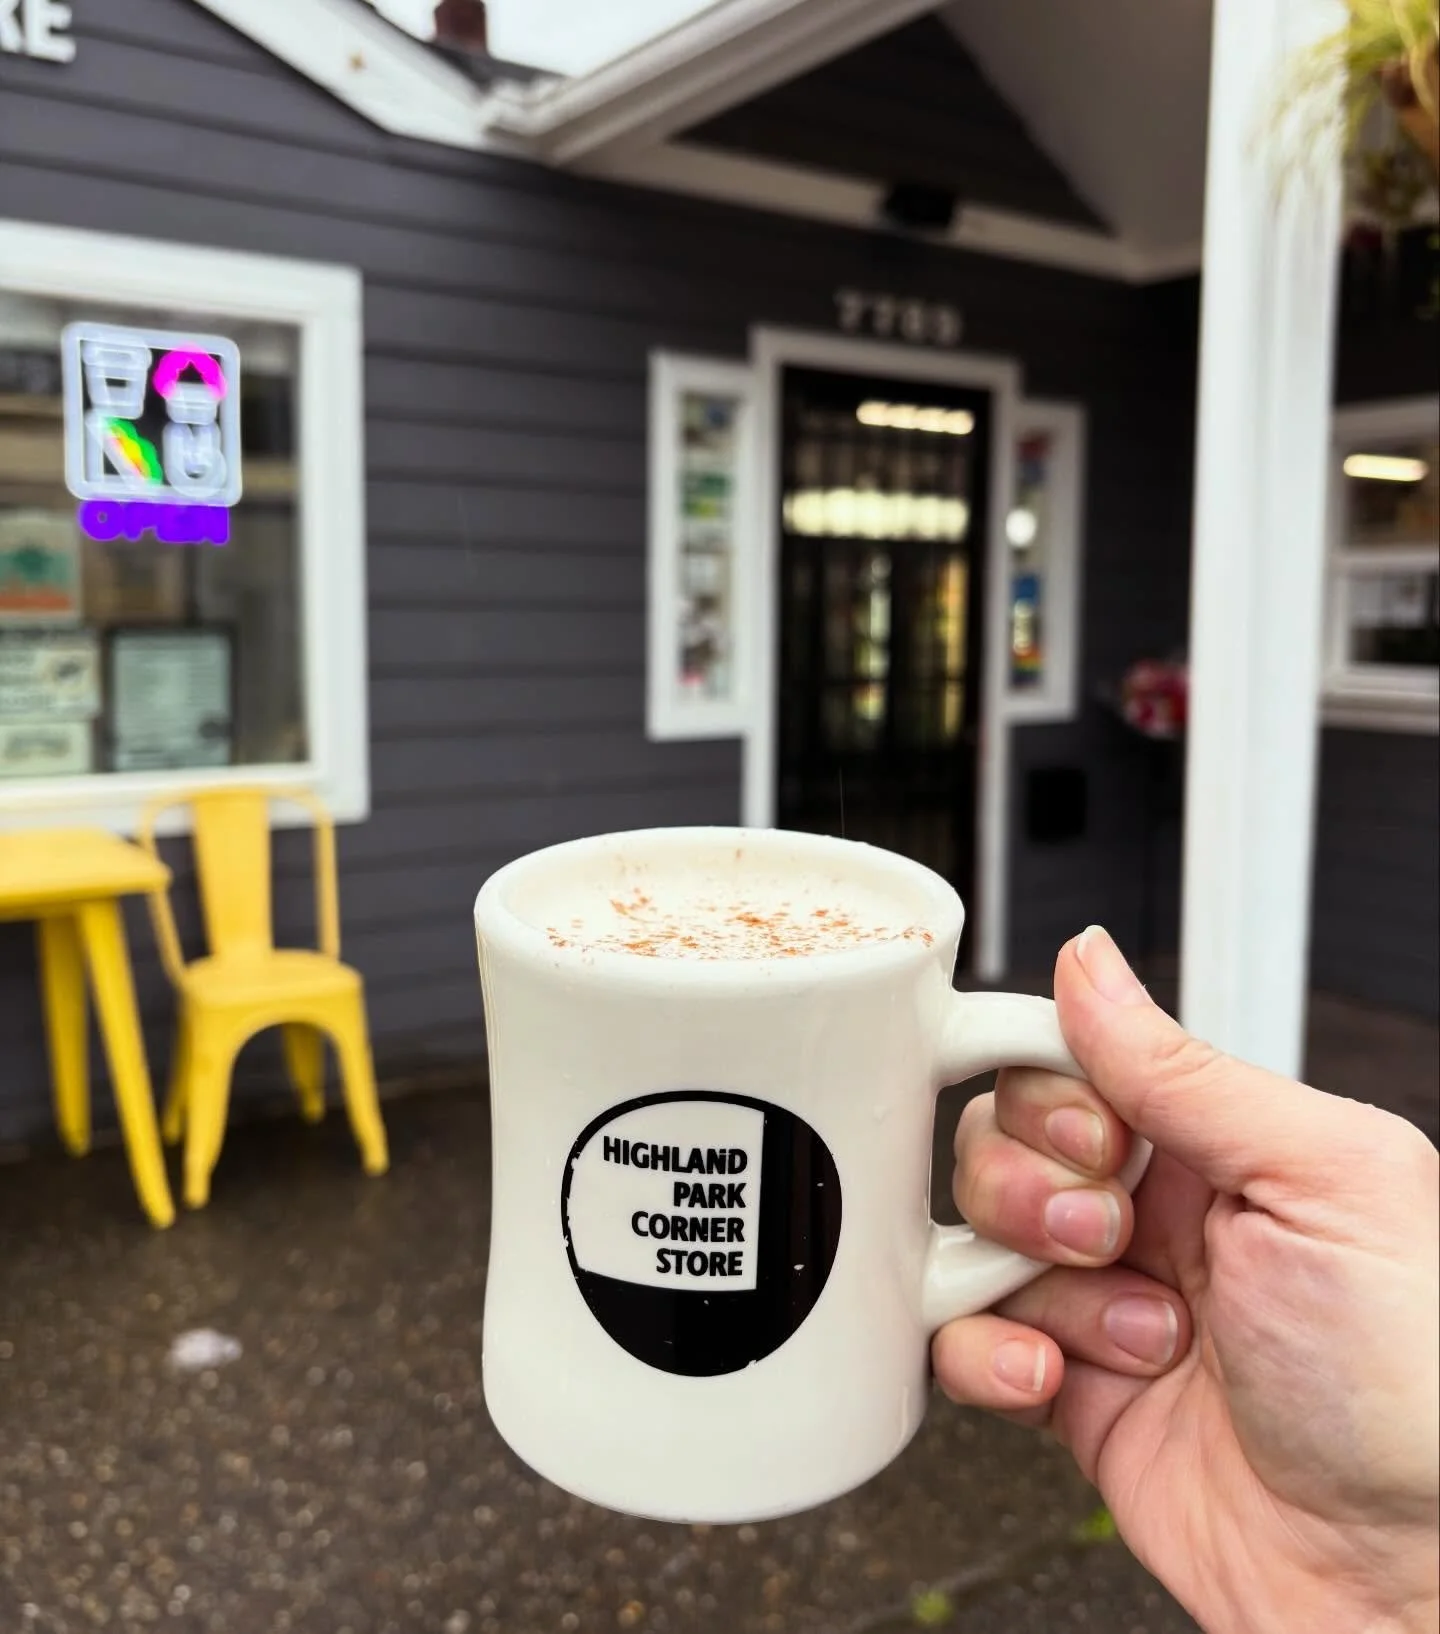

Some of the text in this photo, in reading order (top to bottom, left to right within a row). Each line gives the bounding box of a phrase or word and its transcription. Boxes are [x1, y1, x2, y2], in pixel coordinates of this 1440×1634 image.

[603, 1135, 748, 1175] HIGHLAND
[673, 1181, 747, 1209] PARK
[631, 1210, 746, 1243] CORNER
[656, 1247, 744, 1277] STORE
